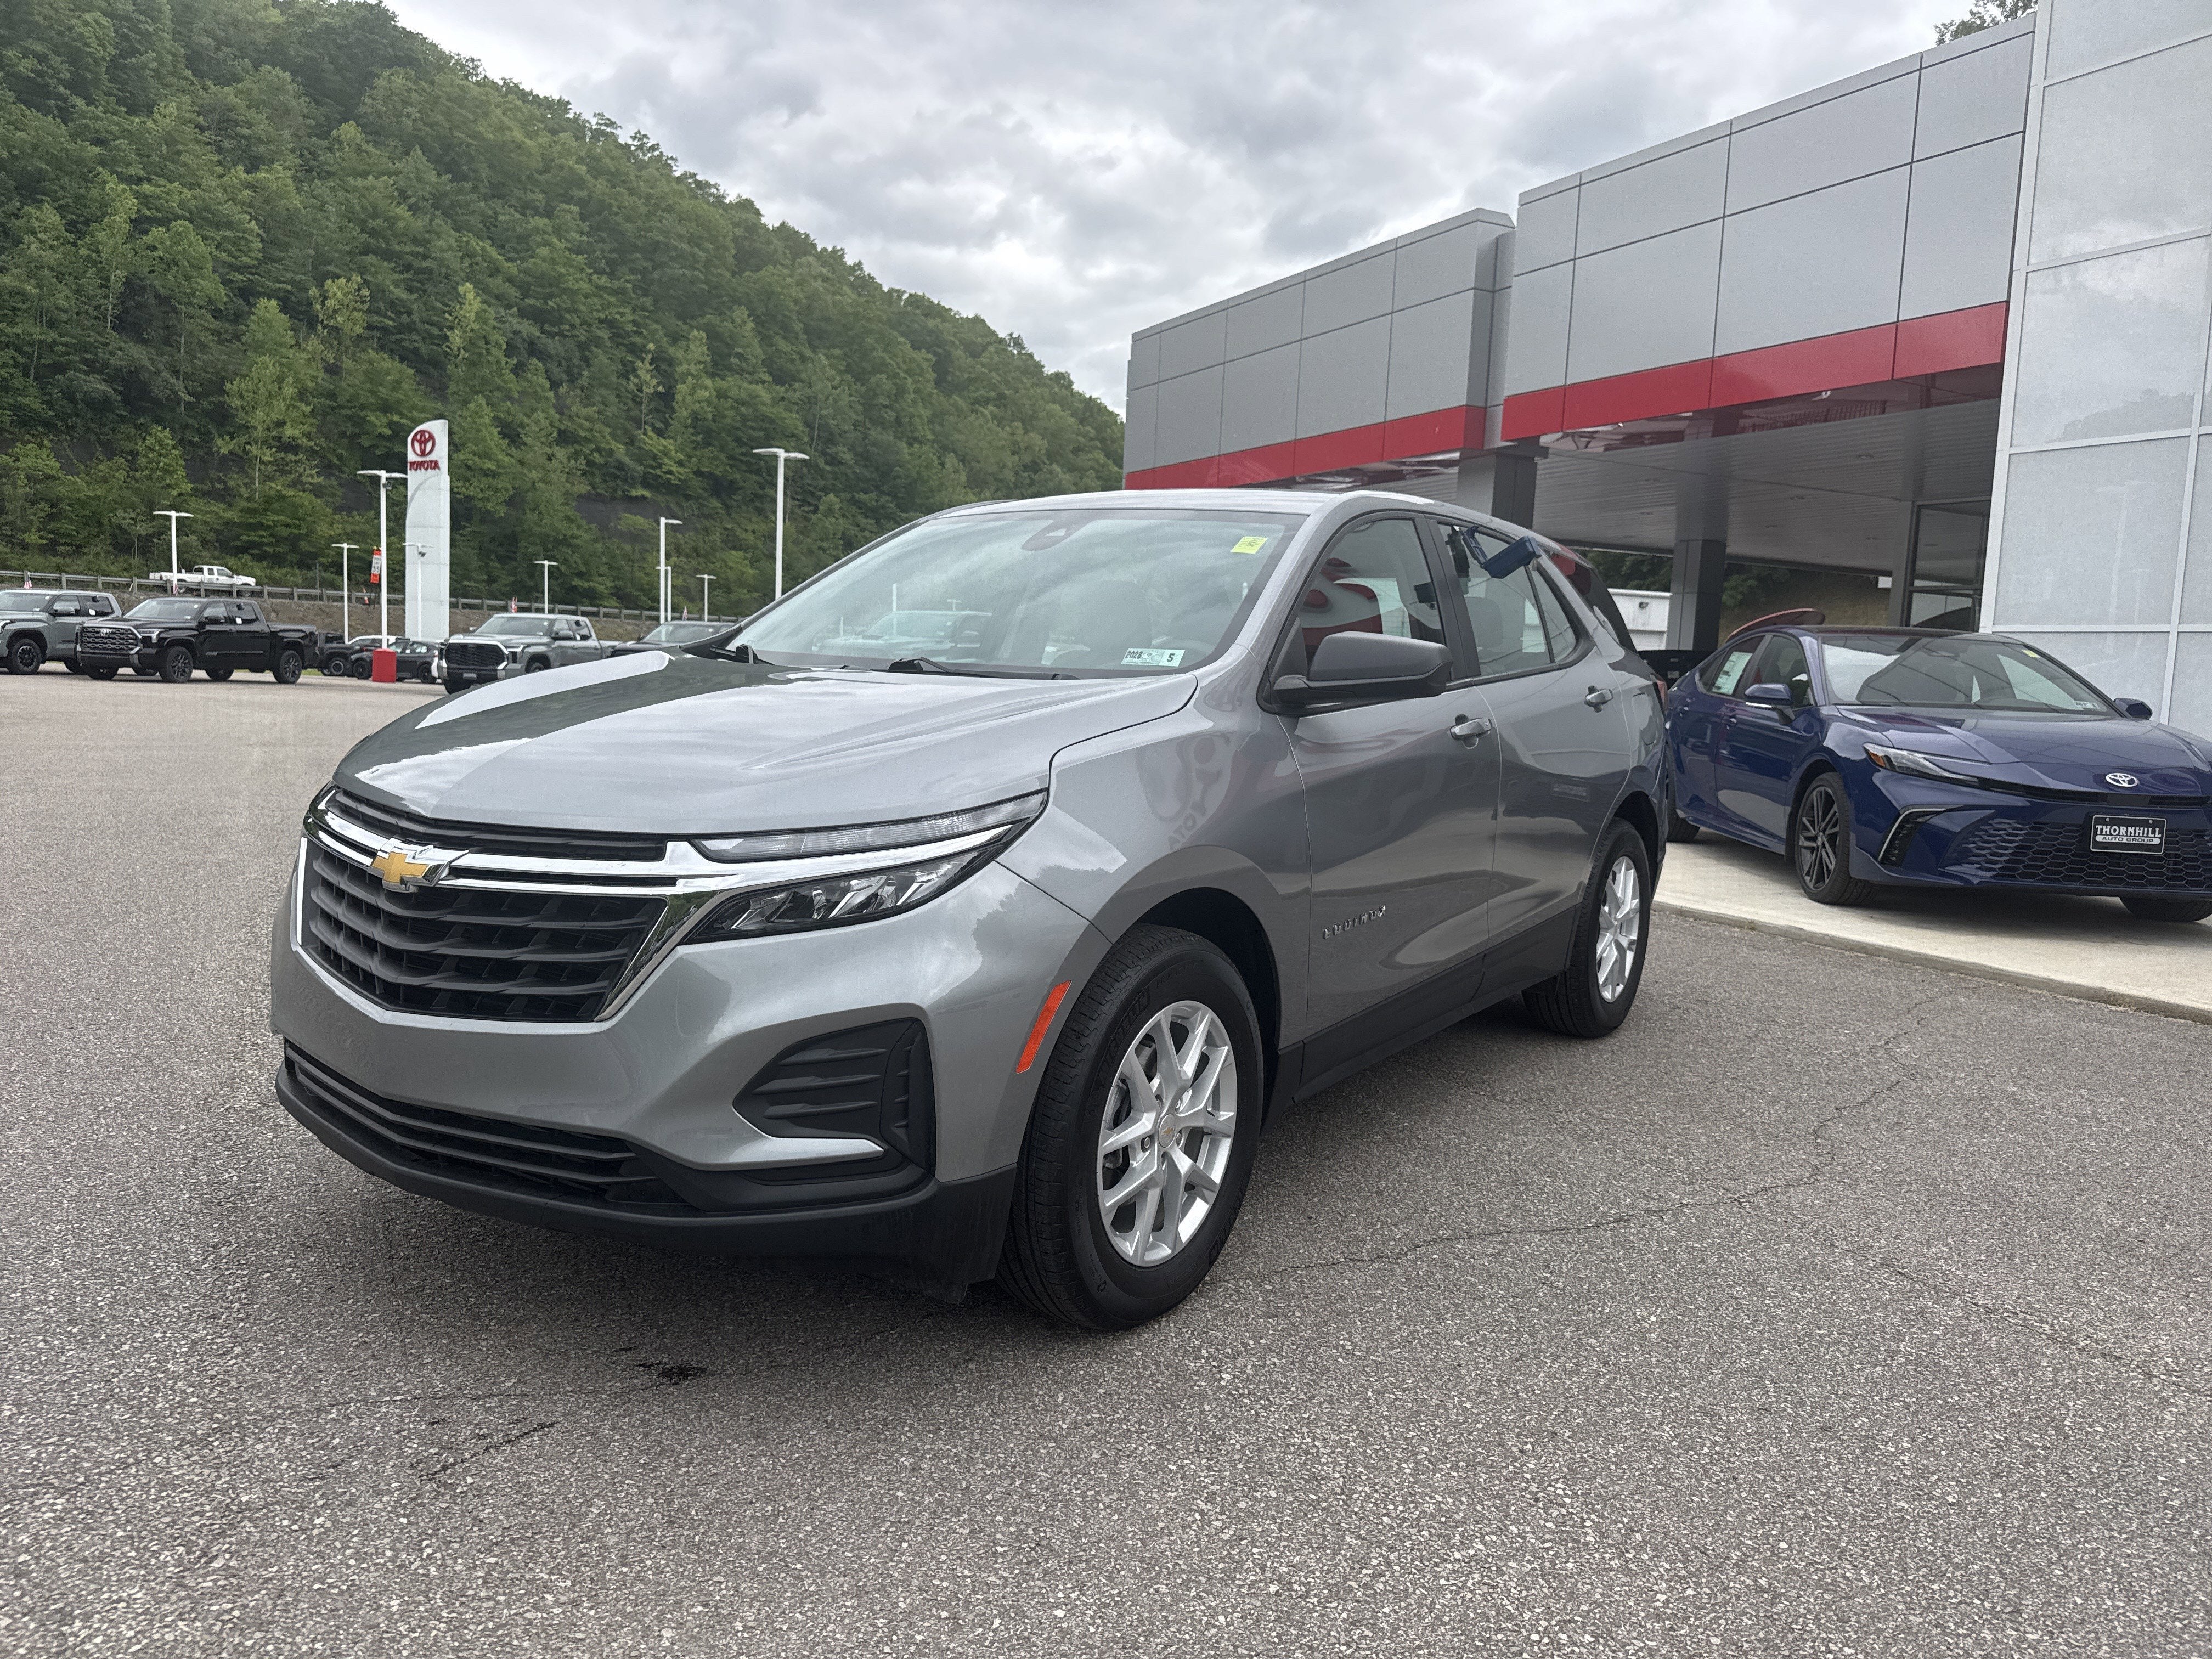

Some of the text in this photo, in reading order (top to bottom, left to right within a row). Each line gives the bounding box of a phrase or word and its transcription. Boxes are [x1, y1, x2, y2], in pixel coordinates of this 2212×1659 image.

[408, 460, 441, 471] TOYOTA
[1125, 651, 1175, 662] 2028 5
[2096, 825, 2162, 837] THORNHILL
